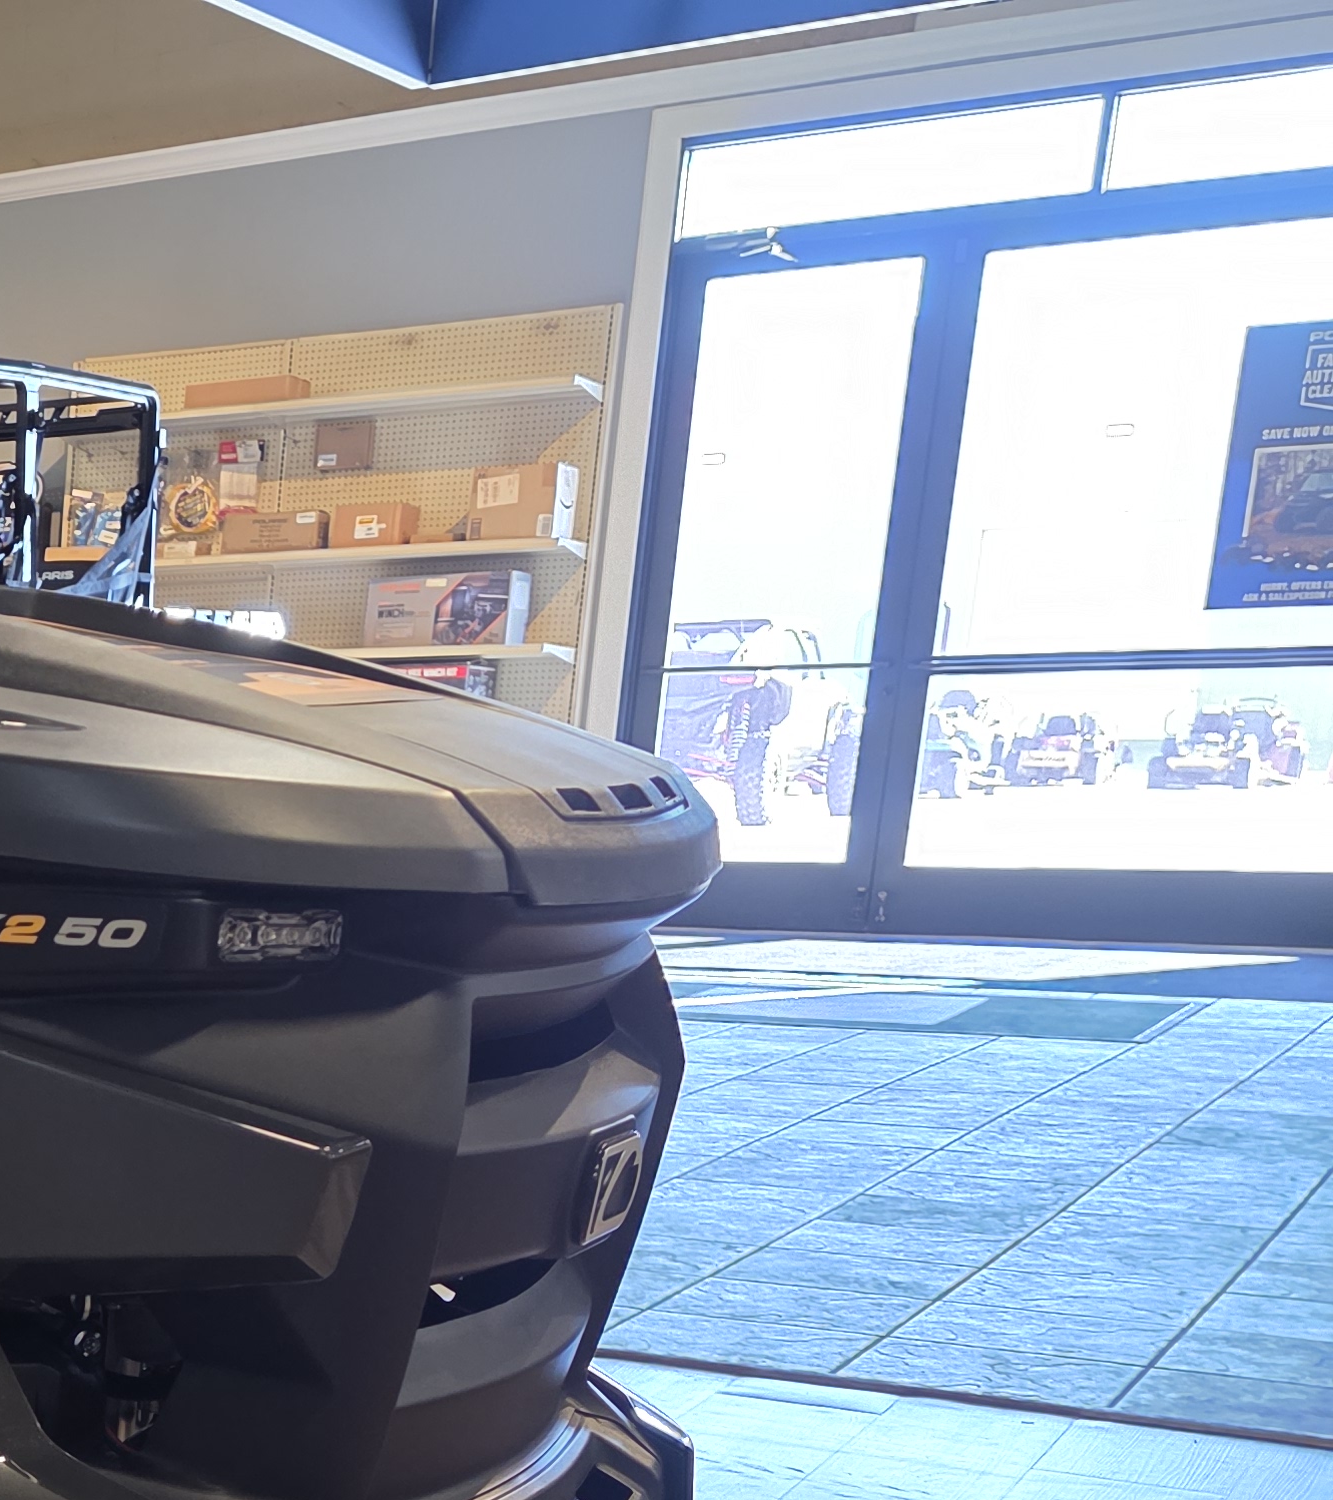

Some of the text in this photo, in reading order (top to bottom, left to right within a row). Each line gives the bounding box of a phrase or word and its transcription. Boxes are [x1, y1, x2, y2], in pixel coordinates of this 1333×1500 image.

[1261, 427, 1292, 440] SAVE
[1293, 425, 1321, 438] NOW
[54, 916, 148, 949] 50
